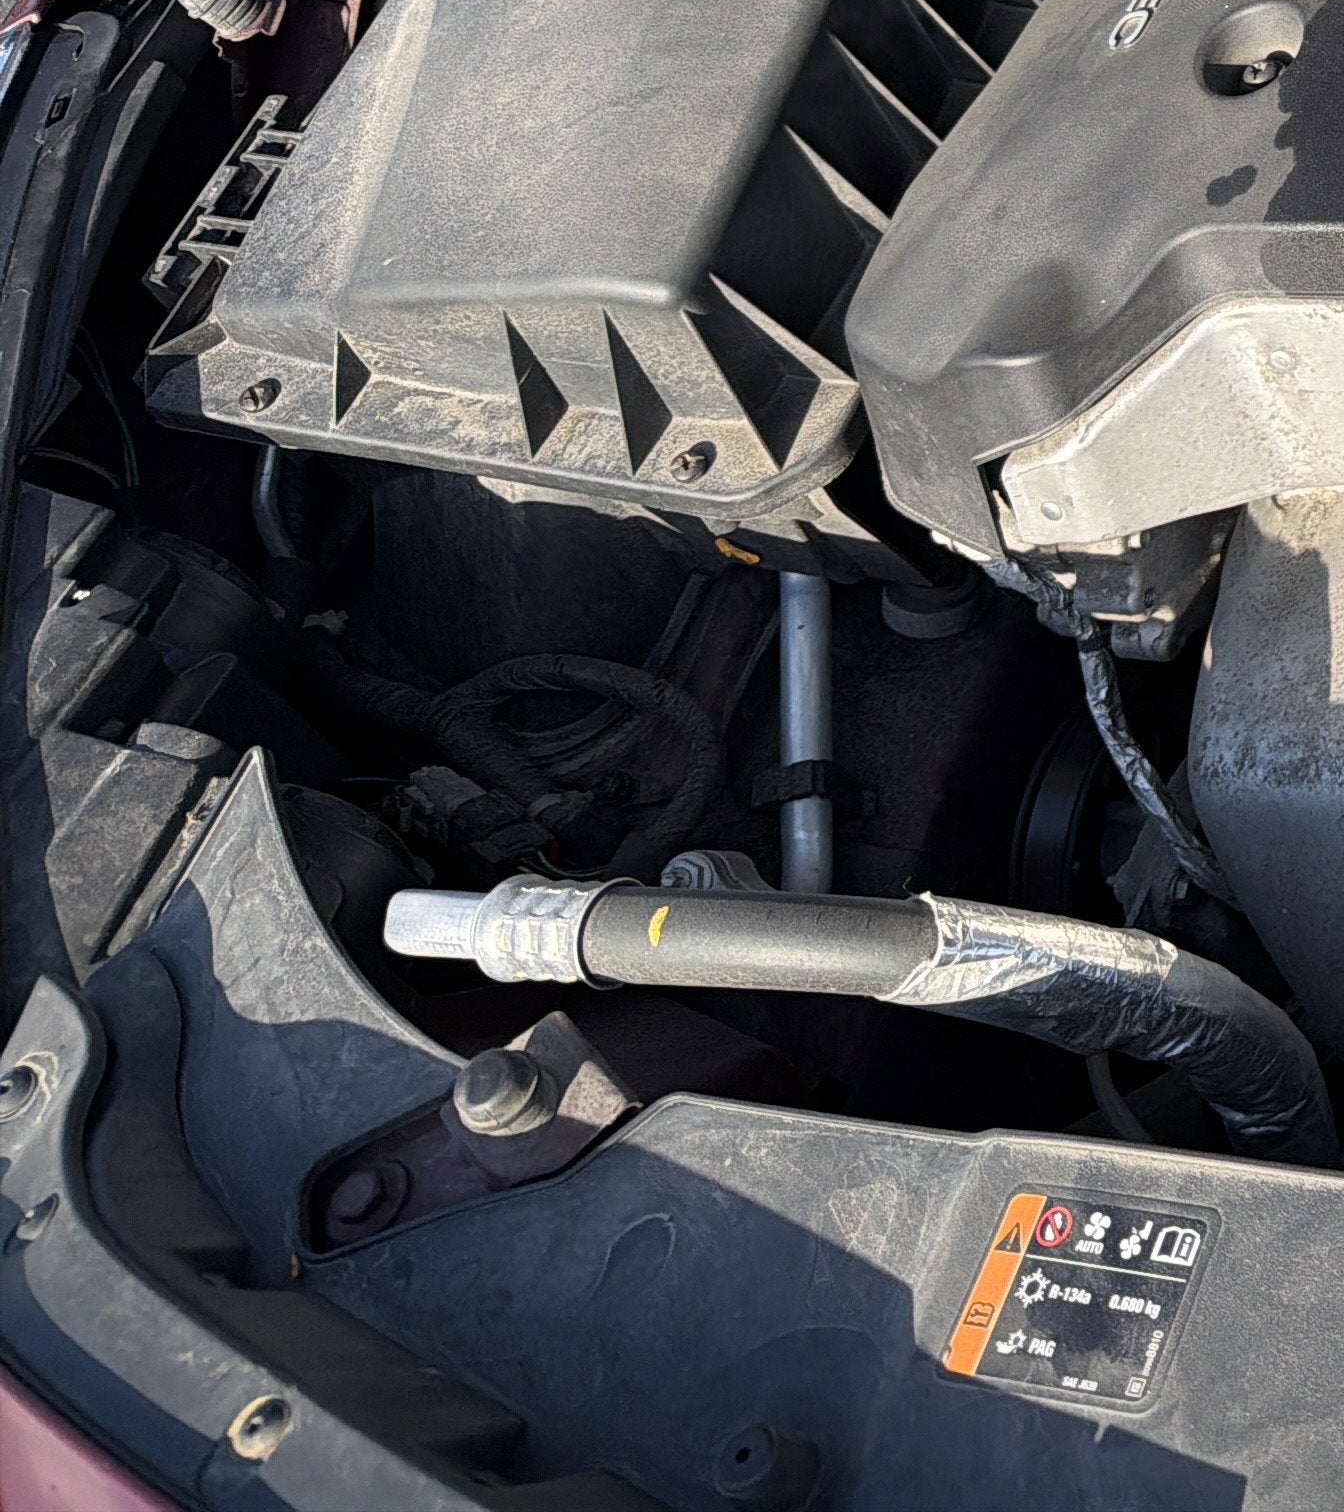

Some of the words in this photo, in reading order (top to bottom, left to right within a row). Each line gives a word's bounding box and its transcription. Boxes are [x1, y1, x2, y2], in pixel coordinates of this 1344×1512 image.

[1074, 1240, 1104, 1255] AUTO
[1048, 1284, 1092, 1305] R-134a
[1108, 1294, 1145, 1314] 0.680
[1145, 1300, 1161, 1320] kg
[1028, 1338, 1057, 1358] PAG
